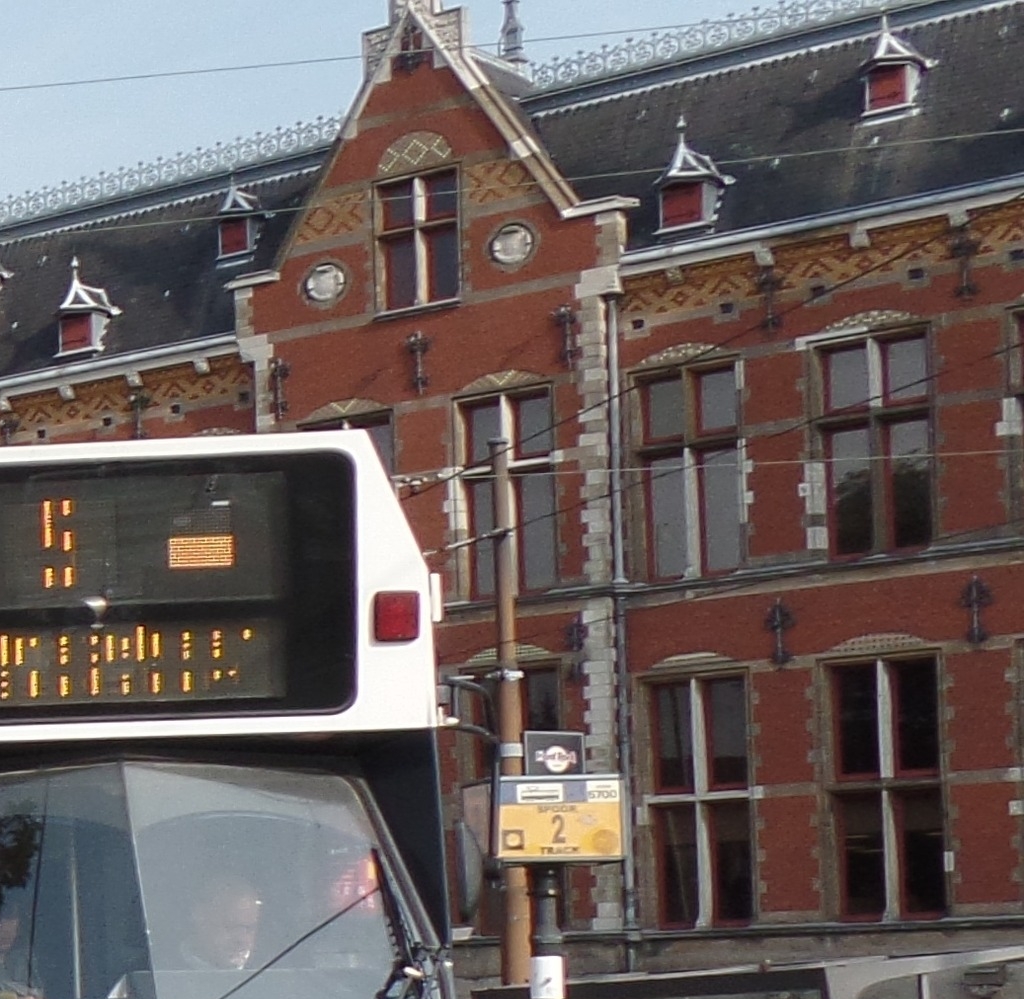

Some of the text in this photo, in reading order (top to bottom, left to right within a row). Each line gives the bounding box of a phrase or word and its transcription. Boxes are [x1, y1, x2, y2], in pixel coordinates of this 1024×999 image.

[588, 790, 618, 799] 5700
[551, 814, 566, 844] 2
[540, 846, 581, 855] TRACK
